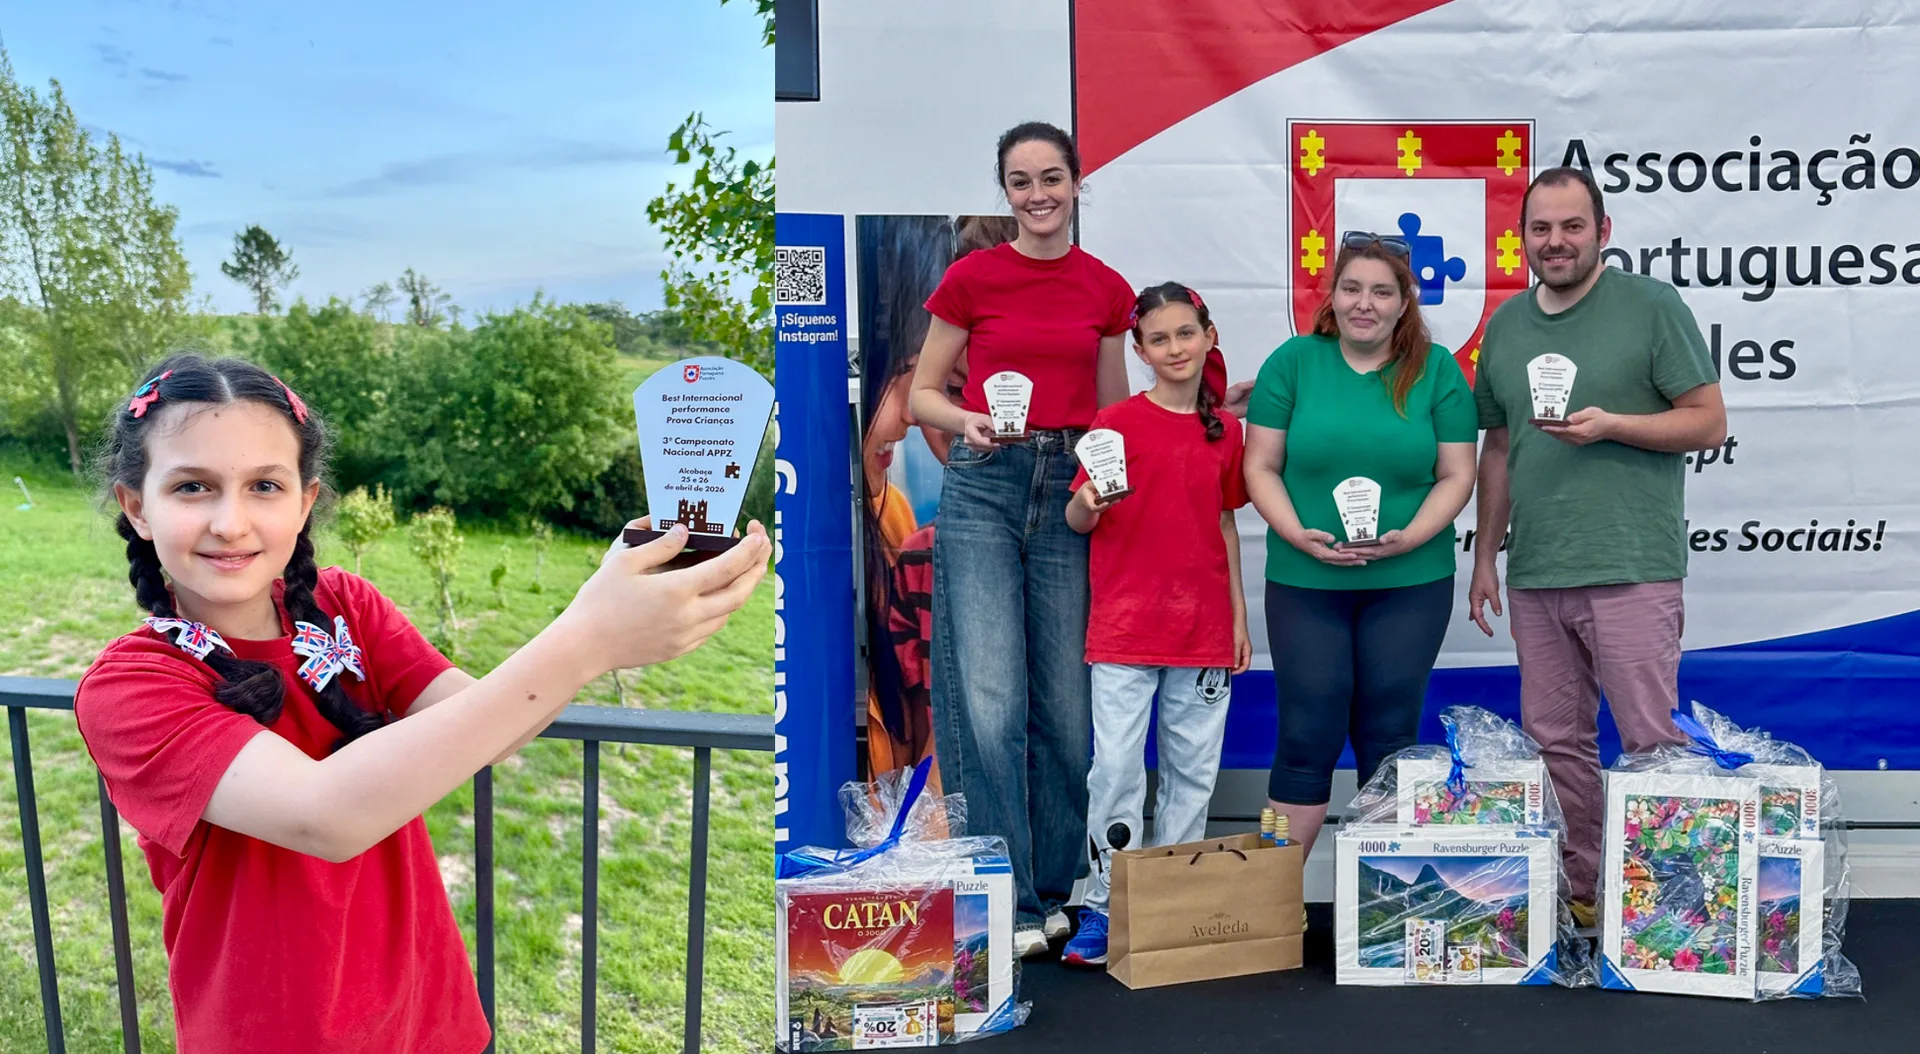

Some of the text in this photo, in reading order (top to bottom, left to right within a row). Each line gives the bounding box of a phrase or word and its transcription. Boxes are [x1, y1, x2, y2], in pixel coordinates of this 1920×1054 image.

[1561, 133, 1920, 206] Associação
[1601, 237, 1920, 302] ortuguesa
[782, 313, 837, 327] ¡Síguenos
[779, 330, 838, 344] Instagram!
[682, 394, 743, 402] Internacional
[672, 405, 730, 414] performance
[694, 416, 734, 426] Crianças
[674, 437, 735, 447] Campeonato
[662, 448, 704, 456] Nacional
[678, 468, 712, 476] Alcobaça
[1737, 519, 1887, 551] Sociais!
[1529, 781, 1540, 808] 3000
[1804, 788, 1818, 816] 3000
[1743, 800, 1756, 828] 3000
[1358, 840, 1386, 852] 4000
[1433, 842, 1530, 854] Ravensburger Puzzle
[956, 880, 988, 891] Puzzle
[824, 900, 918, 930] CATAN
[1189, 920, 1249, 938] Aveleda
[1739, 878, 1752, 976] Ravensburger Puzzle
[1420, 928, 1431, 956] 20%
[864, 1022, 896, 1033] 20%
